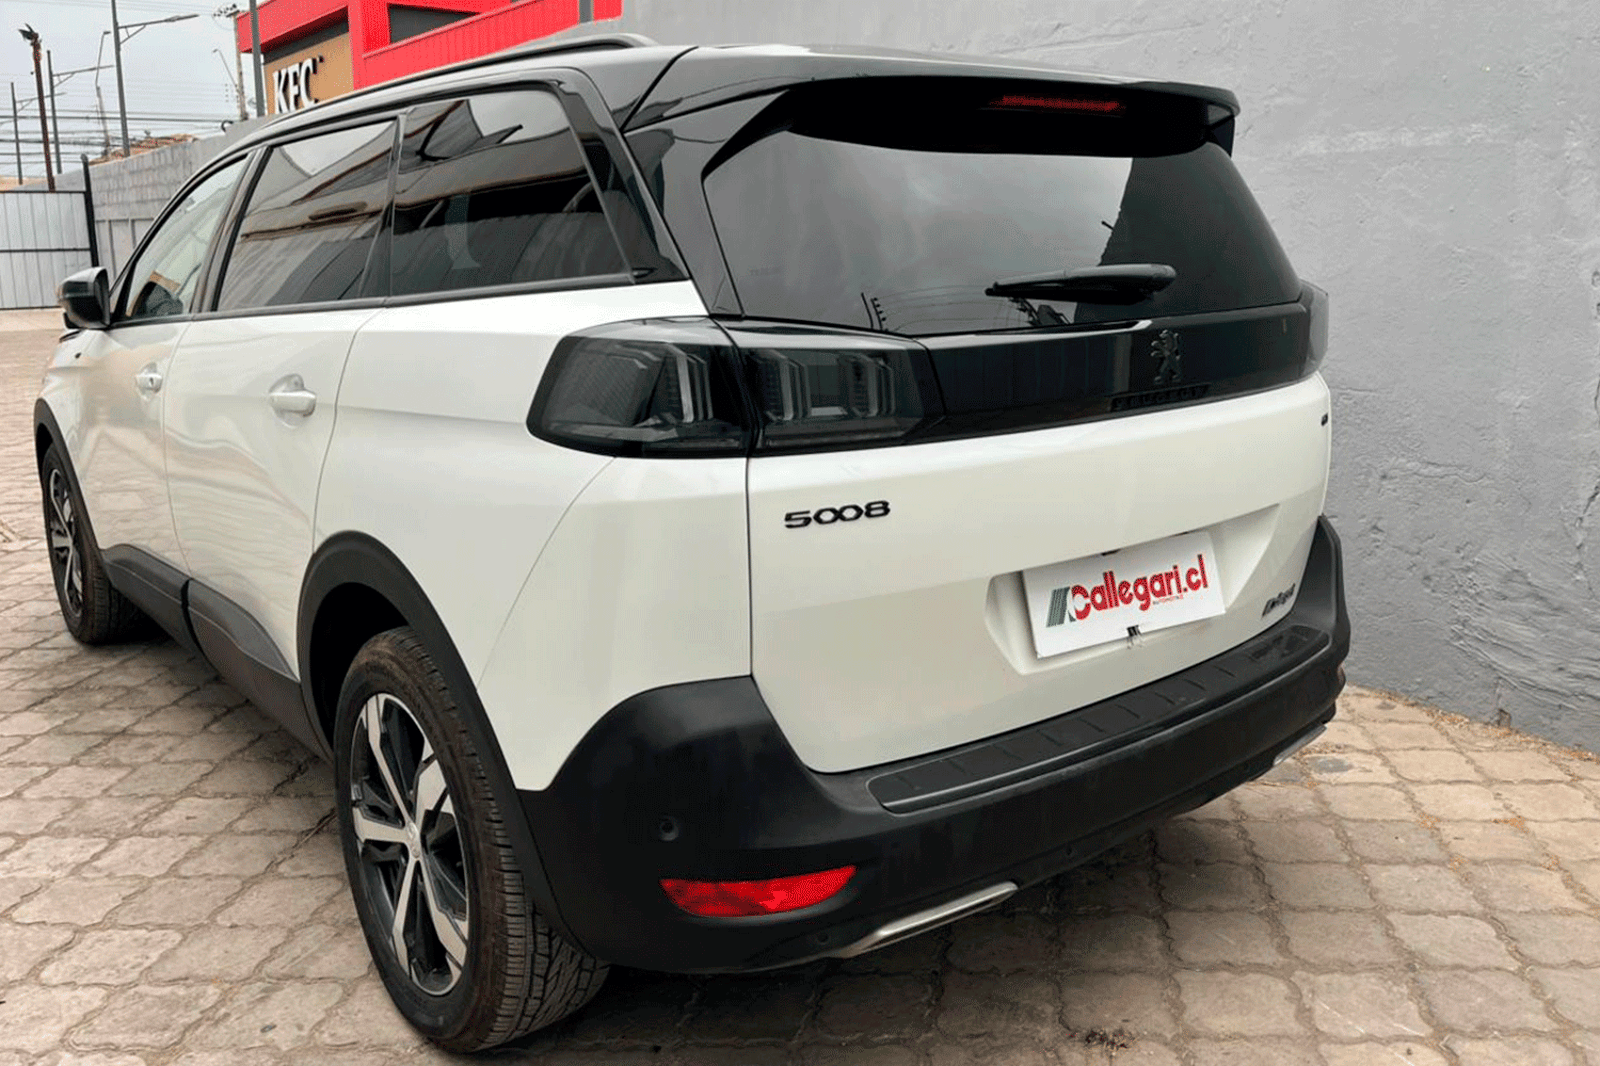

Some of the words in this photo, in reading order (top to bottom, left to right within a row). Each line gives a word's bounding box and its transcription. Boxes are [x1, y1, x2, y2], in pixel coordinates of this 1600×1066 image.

[273, 58, 317, 114] KFC
[784, 500, 891, 529] 5008
[1071, 554, 1208, 621] Callegari.cl
